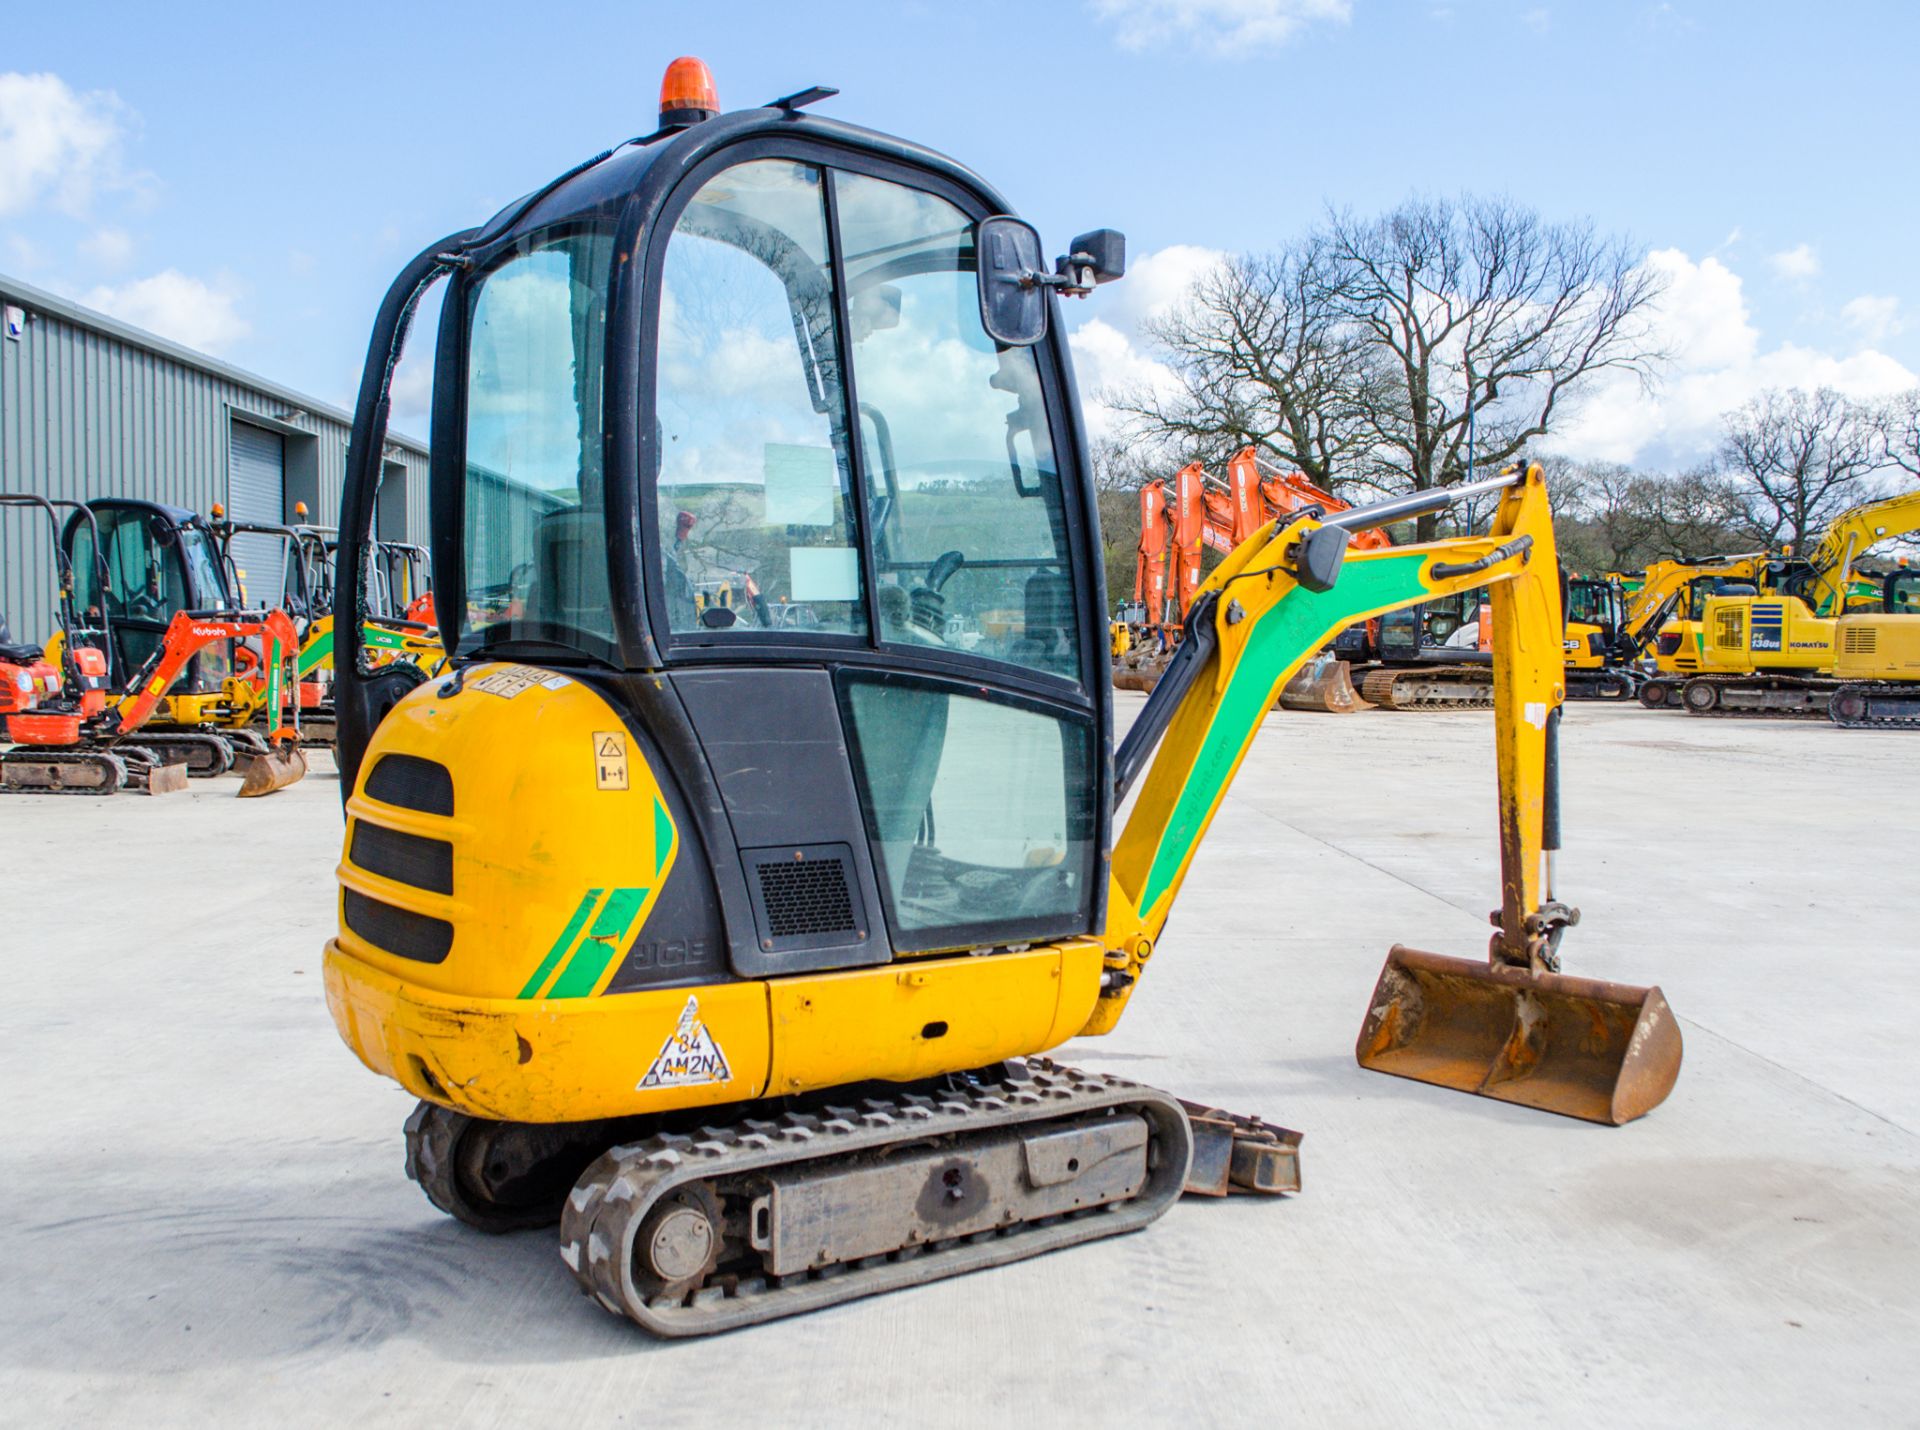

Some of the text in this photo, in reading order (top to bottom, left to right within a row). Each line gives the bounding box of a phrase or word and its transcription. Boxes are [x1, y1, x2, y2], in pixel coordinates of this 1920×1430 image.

[193, 627, 226, 636] Kubota
[1562, 640, 1580, 649] CB
[1790, 641, 1829, 649] KOMATSU
[634, 938, 708, 970] JCB
